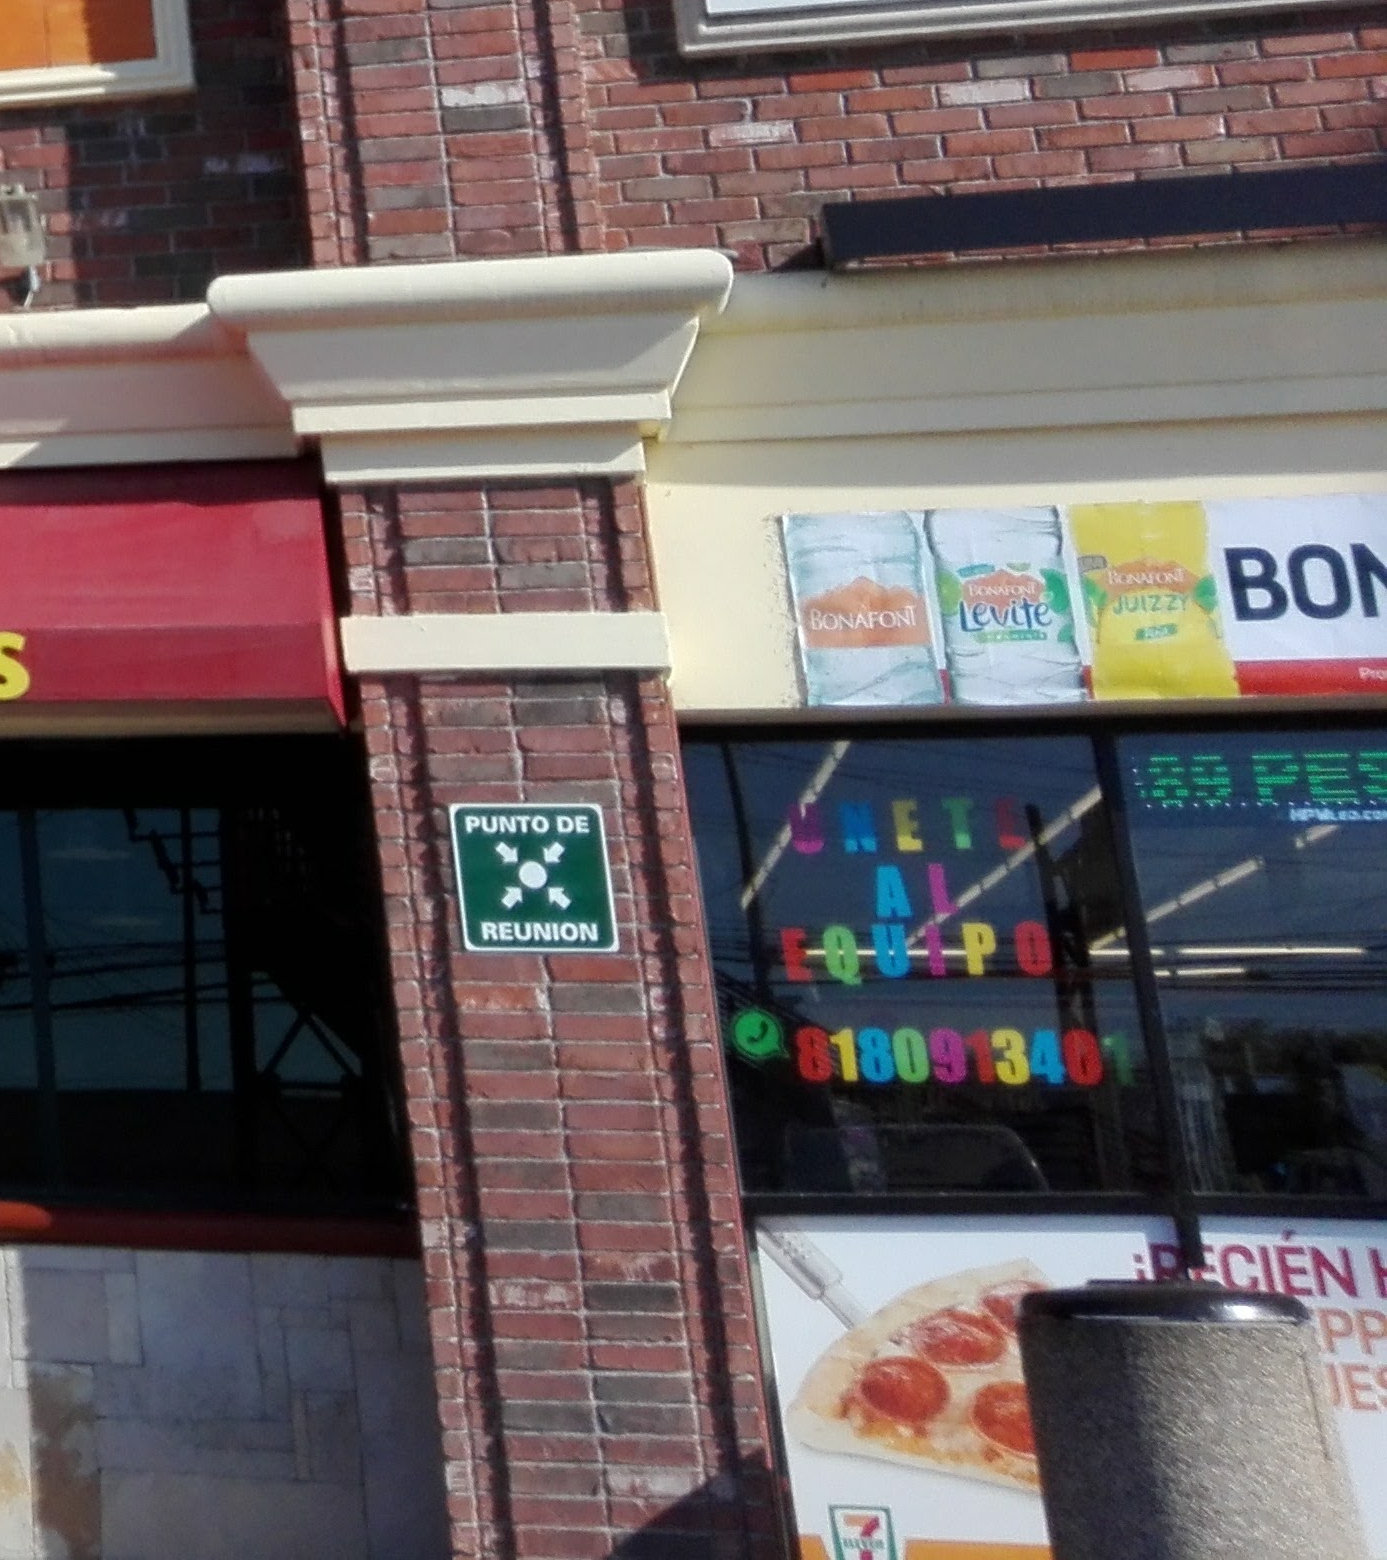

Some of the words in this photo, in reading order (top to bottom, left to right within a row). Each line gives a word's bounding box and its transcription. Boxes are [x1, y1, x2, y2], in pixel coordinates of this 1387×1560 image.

[811, 604, 919, 634] BONAFONT
[465, 815, 549, 833] PUNTO
[556, 815, 590, 833] DE
[875, 863, 957, 918] AL
[480, 921, 598, 941] REUNION
[780, 920, 1052, 986] EQUIPO
